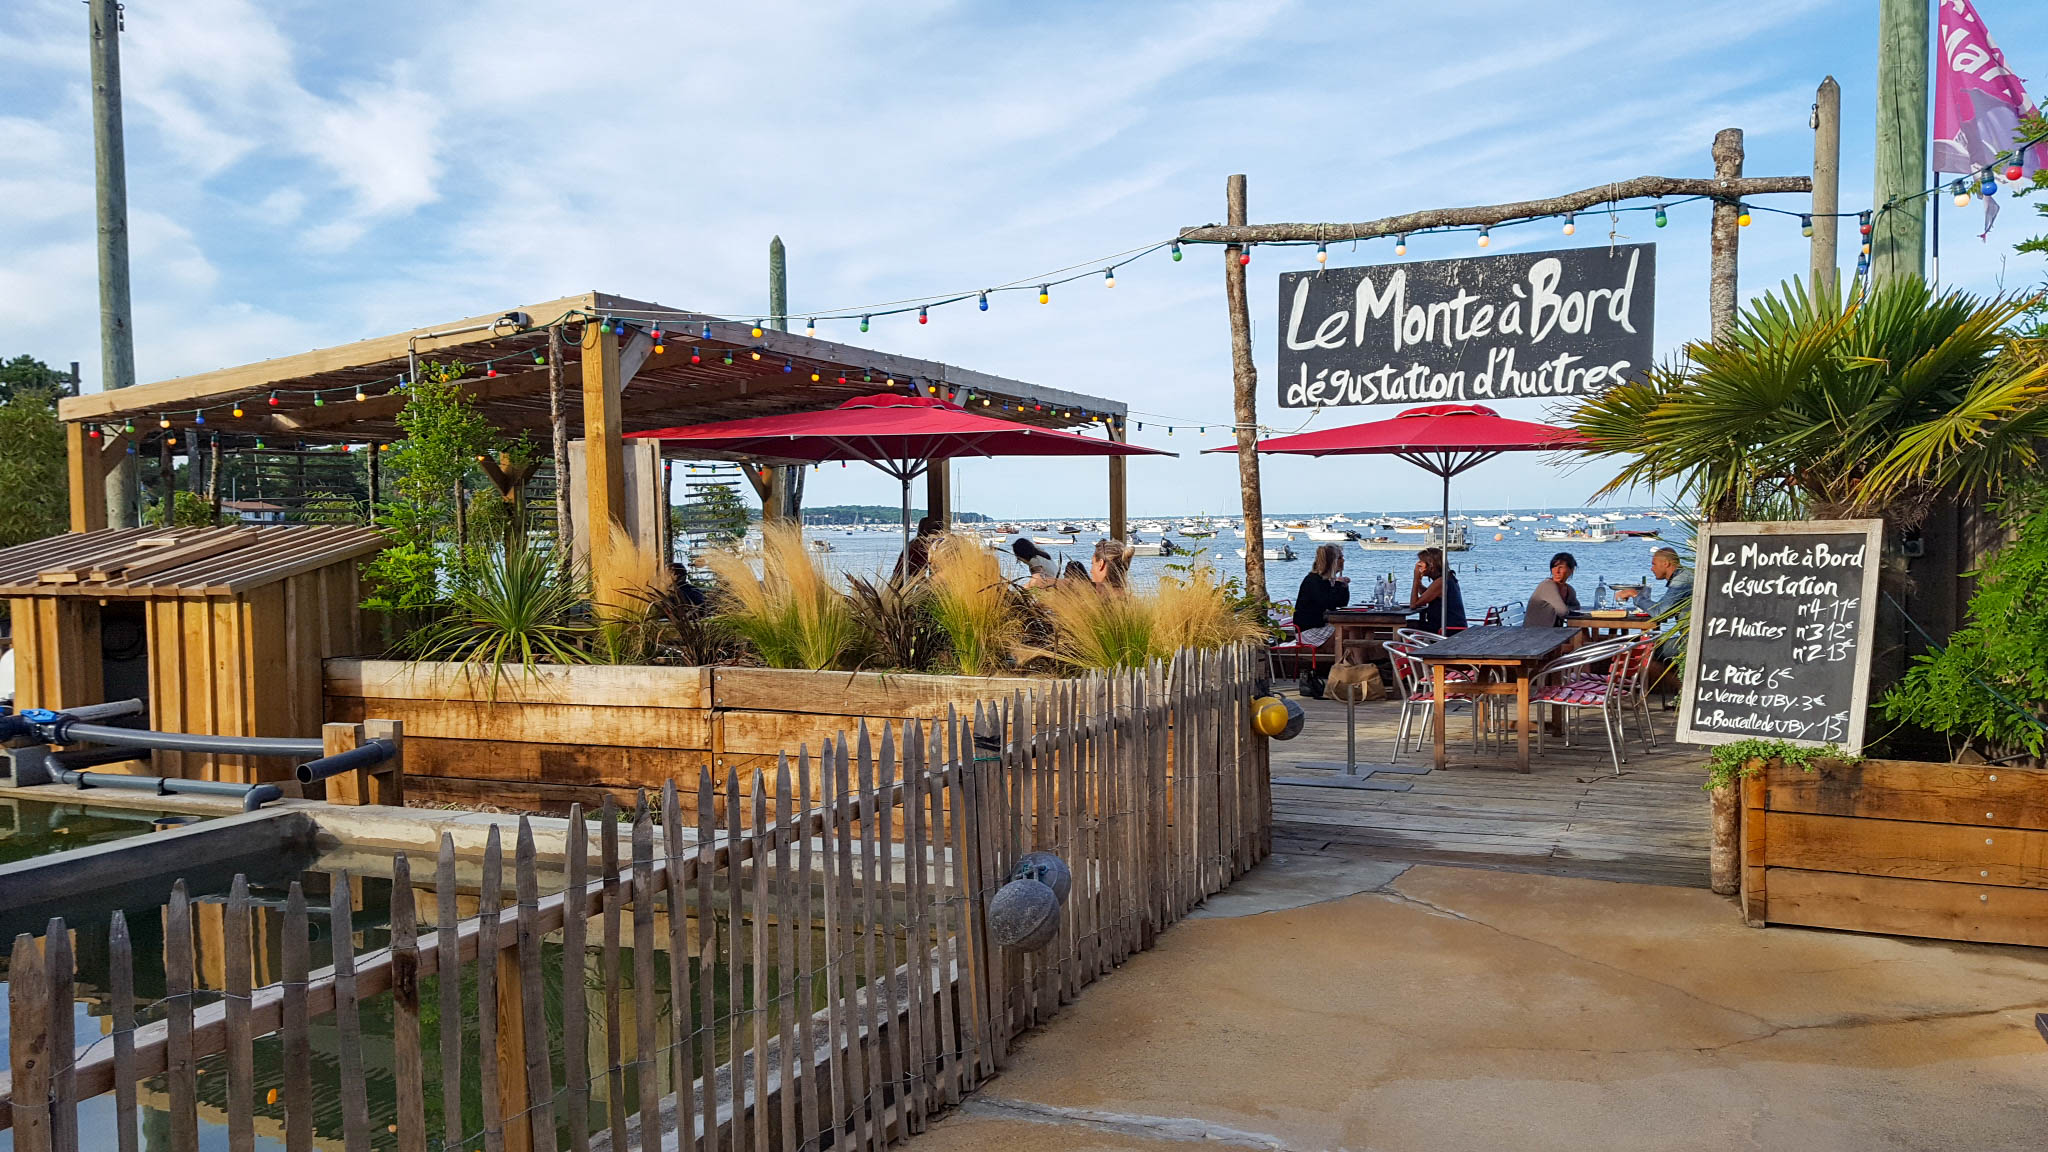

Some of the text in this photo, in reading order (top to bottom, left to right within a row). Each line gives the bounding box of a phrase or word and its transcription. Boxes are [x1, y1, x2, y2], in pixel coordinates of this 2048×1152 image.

[1286, 248, 1641, 352] Le Monte à Bord
[1287, 346, 1632, 407] dégustation d'huîtres
[1711, 542, 1866, 569] Le Monte à Bord
[1721, 570, 1838, 598] dégustation
[1708, 617, 1730, 637] 12
[1826, 621, 1854, 641] 12€
[1701, 663, 1795, 689] Le Pâté 6€
[1698, 687, 1713, 702] Le
[1715, 688, 1744, 704] Verre
[1745, 689, 1759, 707] de
[1696, 707, 1711, 727] La
[1761, 714, 1775, 732] de
[1774, 719, 1815, 739] UBY
